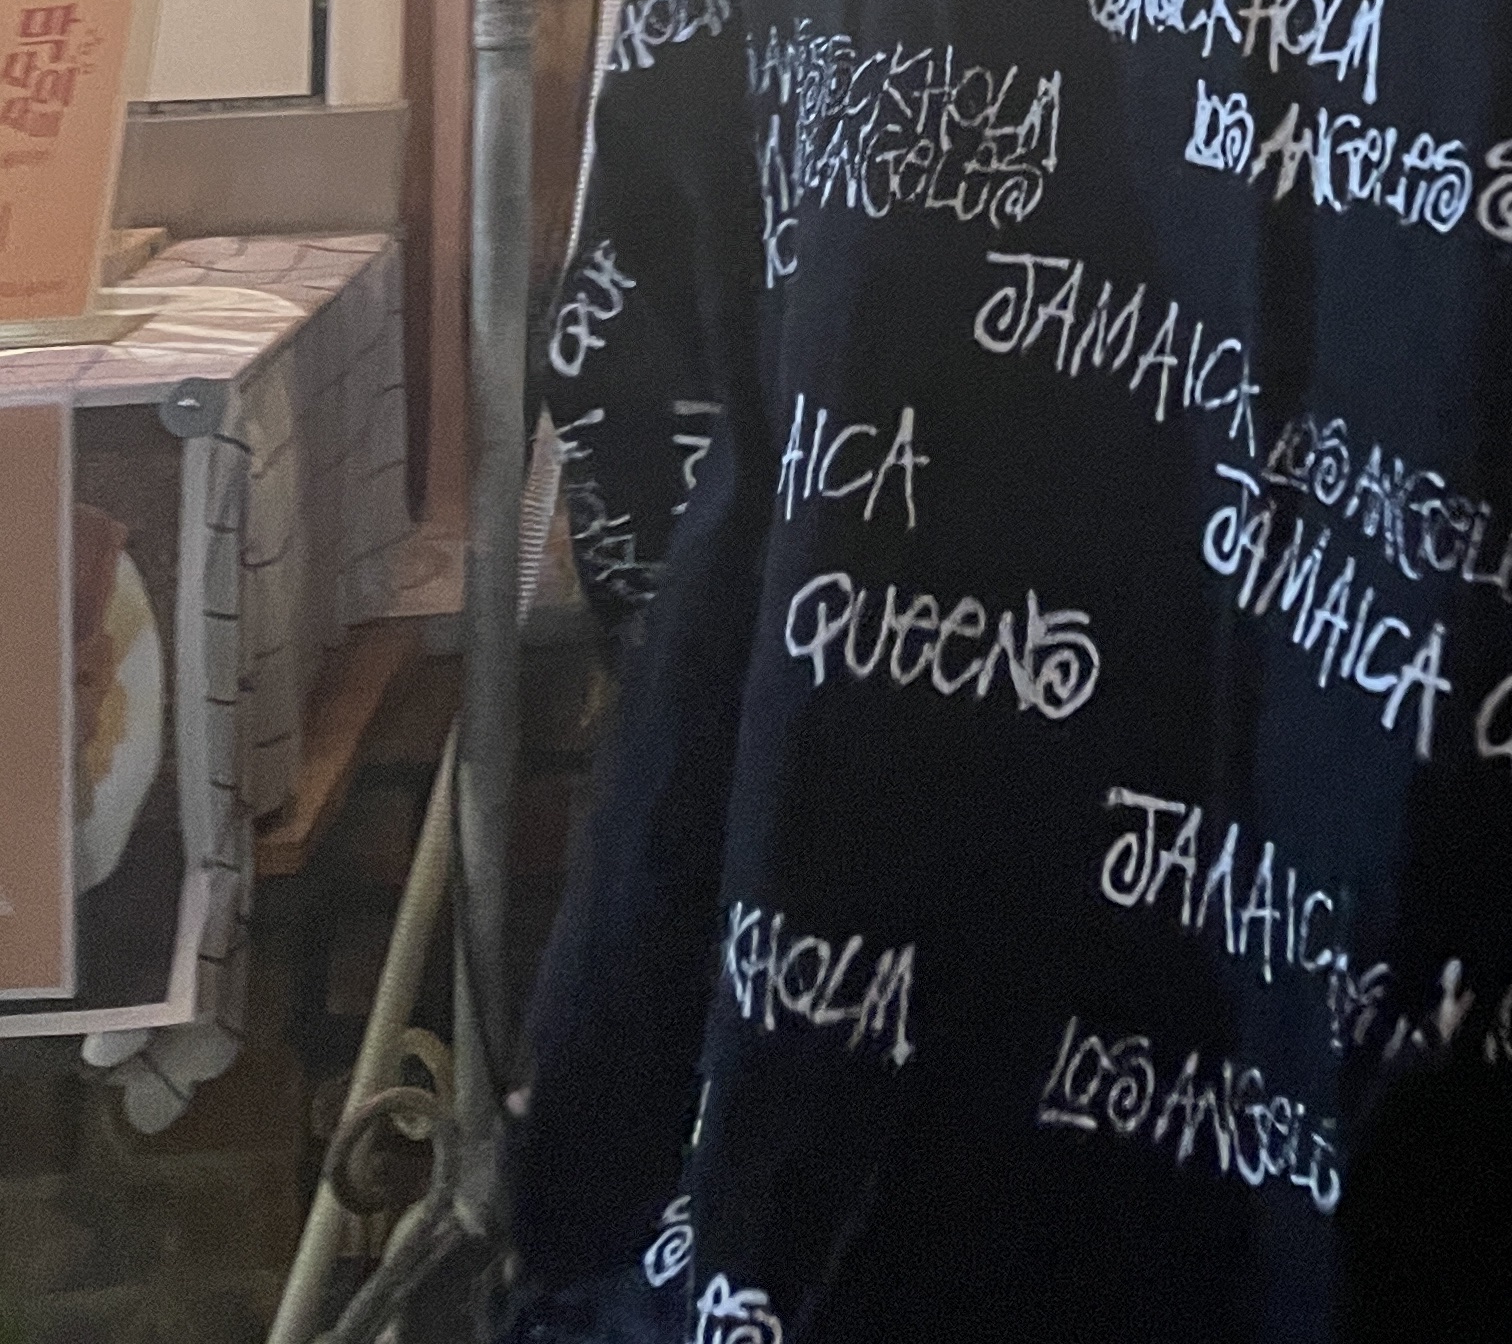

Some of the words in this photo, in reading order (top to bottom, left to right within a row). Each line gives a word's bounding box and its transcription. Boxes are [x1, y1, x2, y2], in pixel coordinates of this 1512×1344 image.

[1246, 100, 1474, 234] ANGELES
[974, 250, 1261, 458] JAMAICA
[785, 570, 1100, 720] QUEENS
[1202, 462, 1452, 762] JAMAICA
[1101, 786, 1350, 984] JAMAIC
[1155, 1050, 1343, 1216] ANGELE
